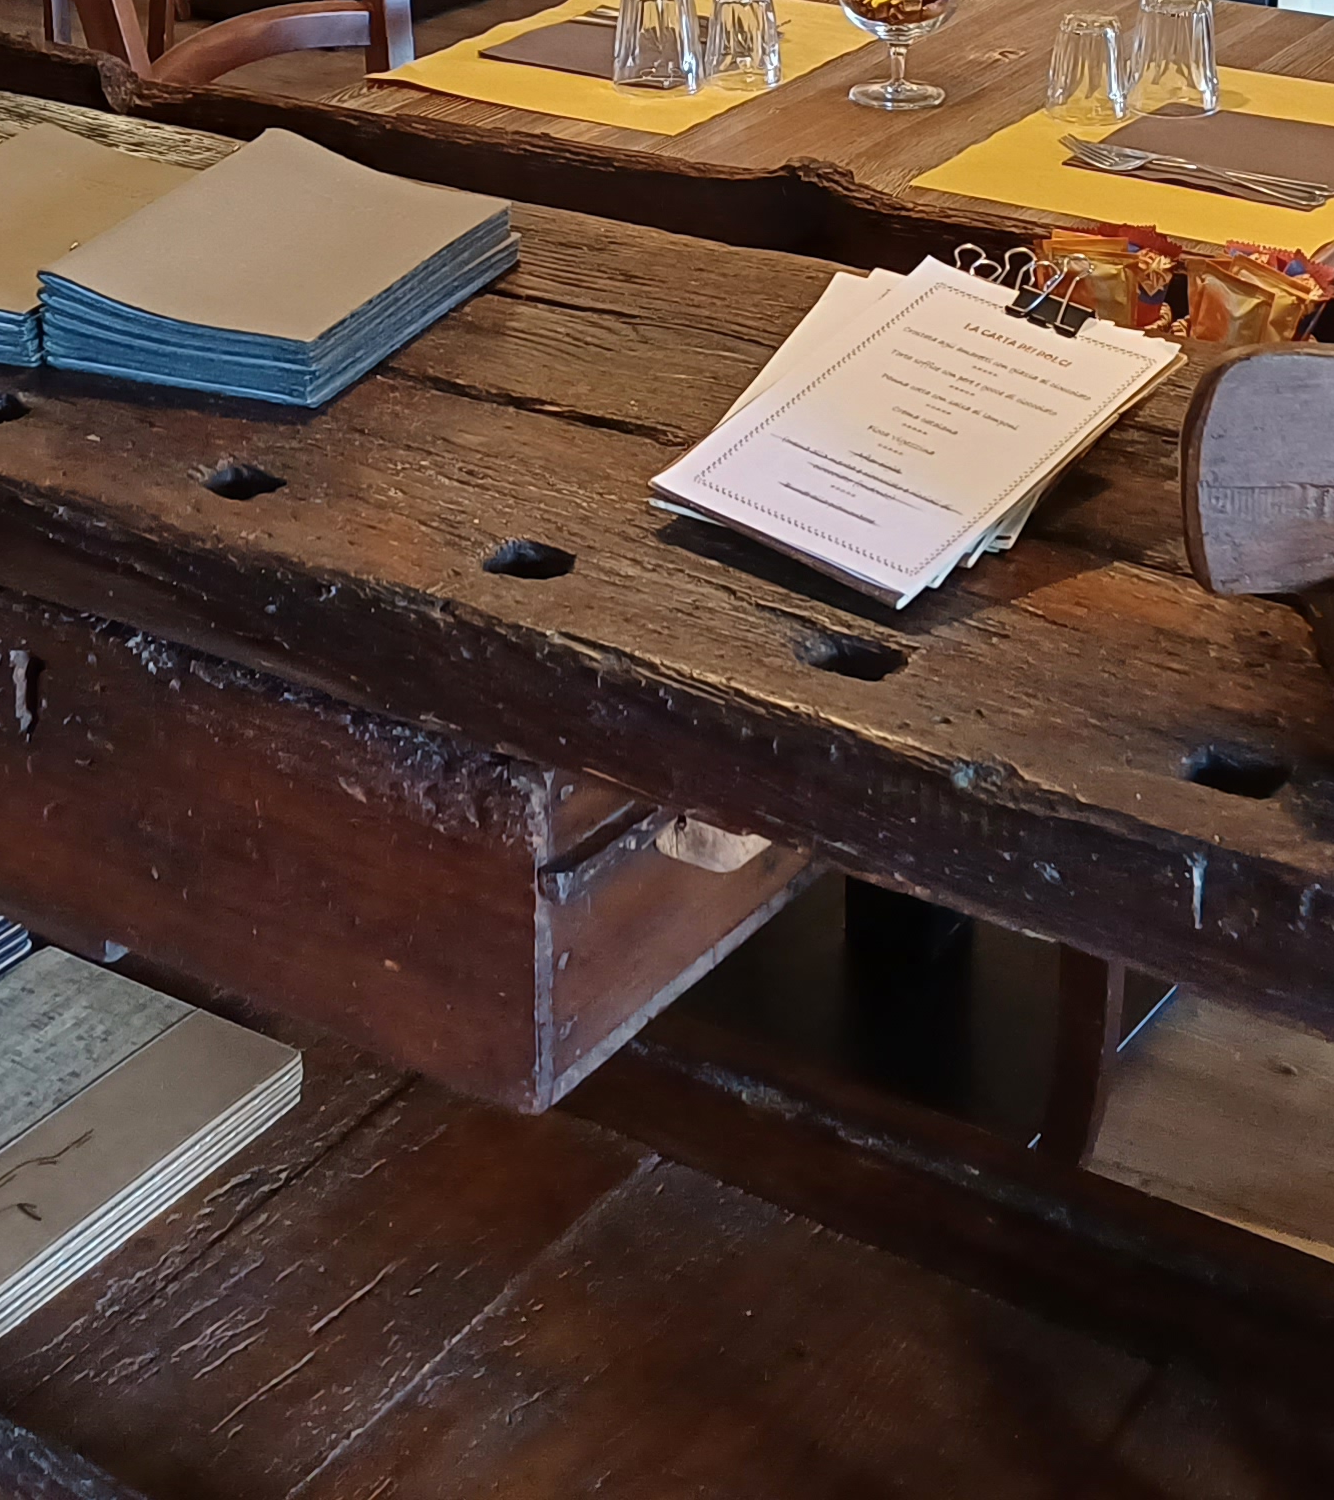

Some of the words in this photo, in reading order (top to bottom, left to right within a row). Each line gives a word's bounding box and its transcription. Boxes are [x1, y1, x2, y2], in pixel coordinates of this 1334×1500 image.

[963, 322, 980, 333] LA
[980, 329, 1017, 347] CARTA
[1016, 343, 1038, 354] DEI
[1035, 350, 1073, 368] DOLCI
[881, 373, 910, 387] Panna
[892, 406, 920, 420] Crema
